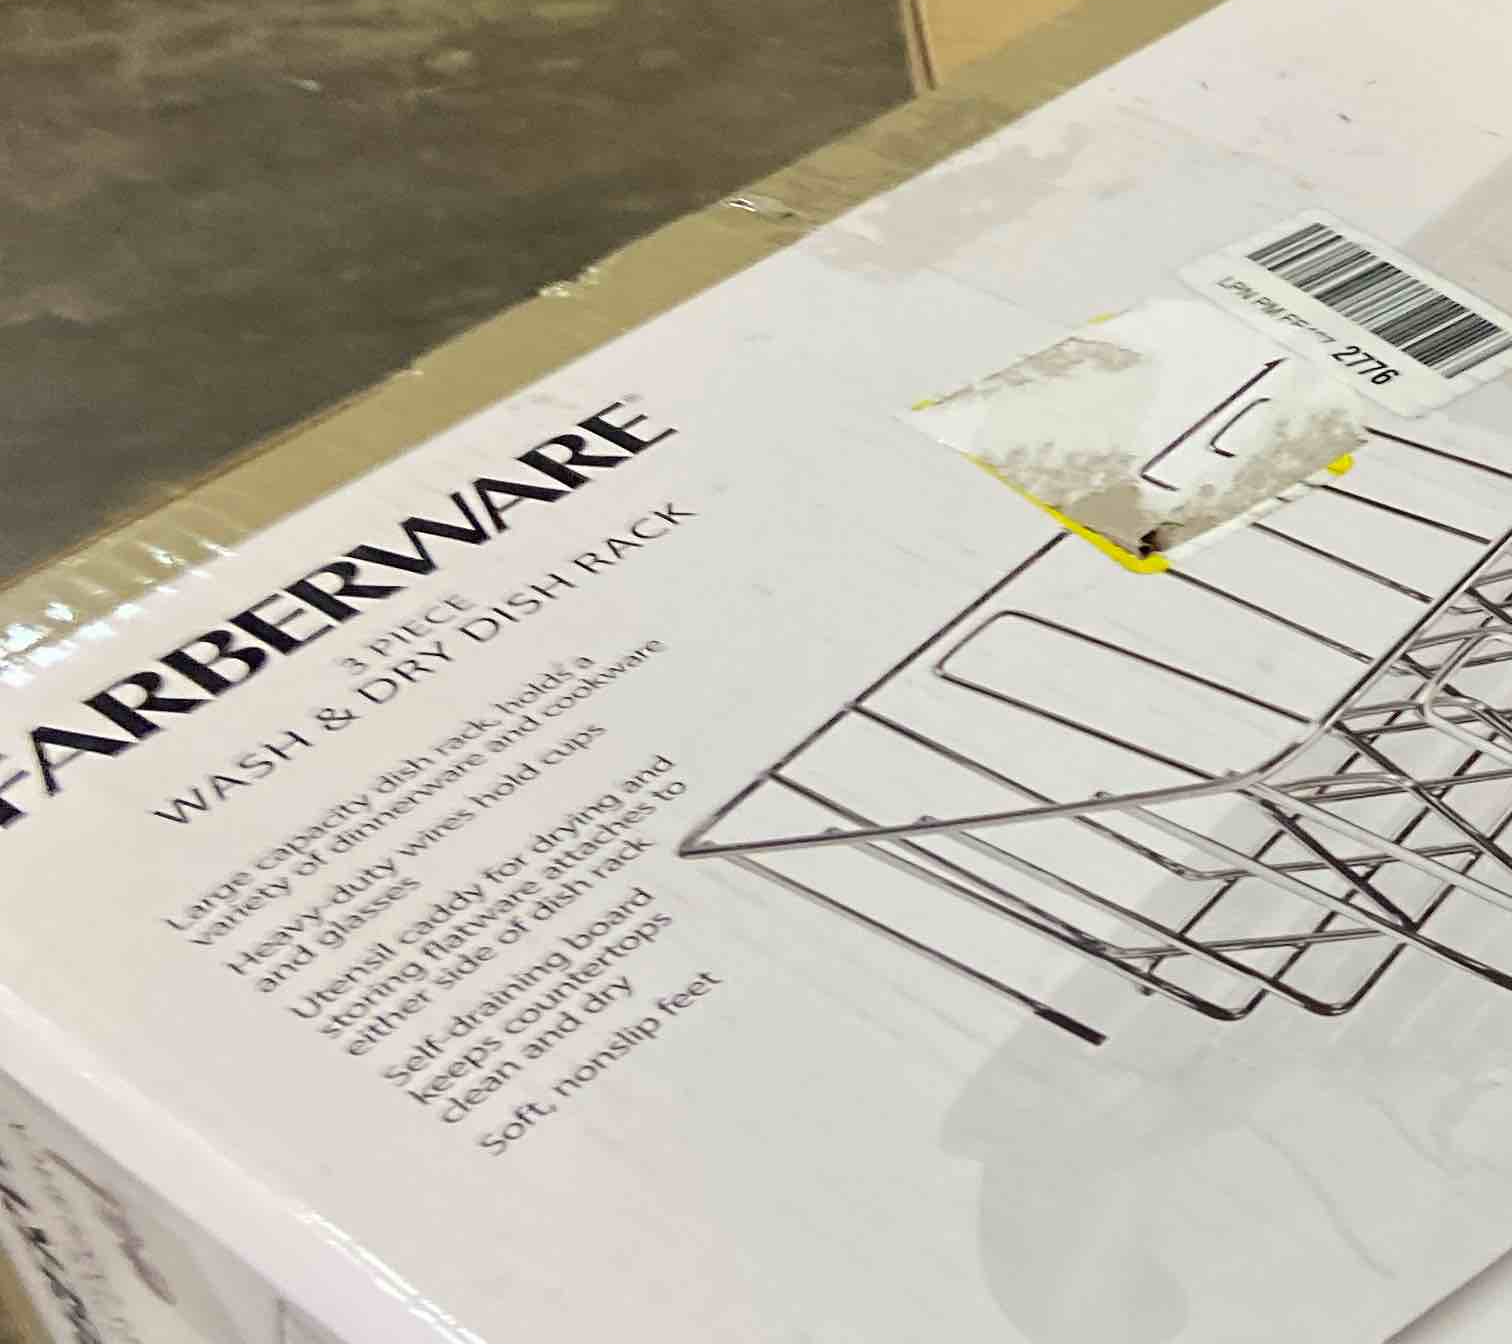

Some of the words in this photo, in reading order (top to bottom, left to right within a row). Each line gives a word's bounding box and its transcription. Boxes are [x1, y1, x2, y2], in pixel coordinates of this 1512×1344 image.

[1331, 345, 1401, 385] 2776
[151, 729, 314, 823] WASH
[313, 708, 359, 731] &
[357, 641, 454, 703] DRY
[459, 573, 578, 642] DISH
[572, 502, 699, 574] RACK
[344, 657, 368, 676] 3
[369, 595, 475, 657] PIECE
[163, 872, 252, 930] Large
[256, 794, 371, 869] capacity
[376, 758, 435, 793] dish
[490, 670, 573, 714] holds
[576, 656, 595, 669] a
[189, 877, 291, 945] variety
[295, 852, 328, 876] of
[331, 753, 487, 853] dinnerware
[485, 714, 543, 753] and
[543, 640, 666, 717] cookware
[290, 942, 398, 1018] Utensil
[400, 884, 484, 944] caddy
[483, 856, 527, 883] for
[532, 794, 623, 853] drying
[622, 755, 675, 793] and
[399, 810, 475, 856] wires
[469, 762, 541, 807] hold
[541, 725, 607, 764] cups
[257, 944, 318, 992] and
[317, 877, 421, 948] glasses
[319, 962, 429, 1038] storing
[422, 881, 542, 959] flatware
[543, 803, 656, 879] attaches
[652, 782, 686, 800] to
[348, 992, 431, 1056] either
[434, 946, 496, 989] side
[498, 918, 531, 944] of
[533, 880, 594, 921] dish
[592, 840, 655, 878] rack
[382, 952, 572, 1087] Self-draining
[561, 886, 655, 950] board
[406, 1036, 502, 1104] keeps
[504, 913, 673, 1034] countertops
[441, 1060, 523, 1123] clean
[522, 1010, 584, 1059] and
[582, 976, 633, 1014] dry
[478, 1102, 557, 1156] Soft,
[554, 1016, 661, 1097] nonslip
[656, 971, 723, 1016] feet
